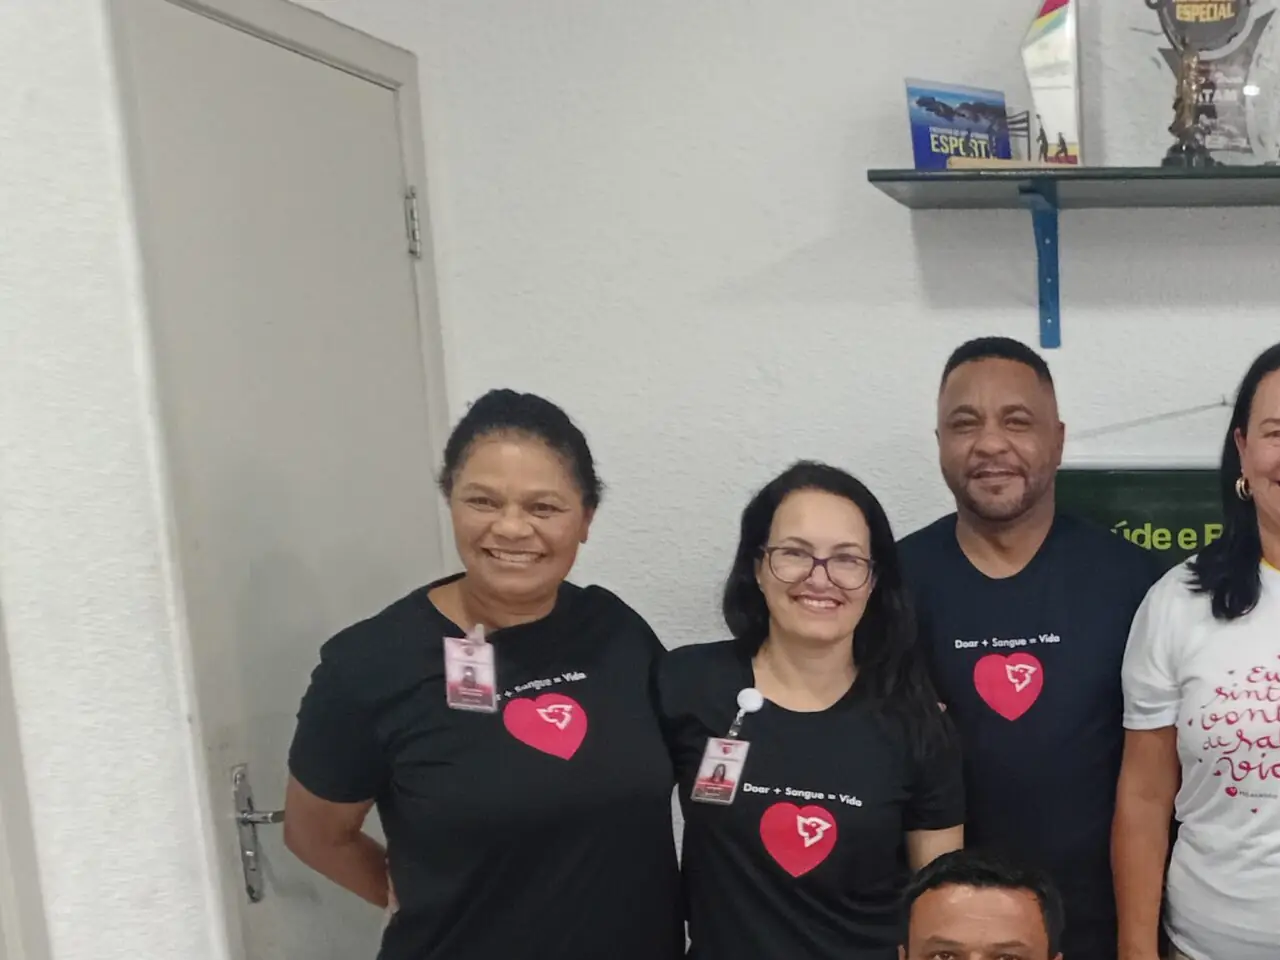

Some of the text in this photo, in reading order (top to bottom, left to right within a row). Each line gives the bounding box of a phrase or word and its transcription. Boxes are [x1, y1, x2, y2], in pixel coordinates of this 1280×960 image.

[1176, 2, 1235, 22] ESPECIAL
[931, 134, 994, 159] ESPORT
[1177, 528, 1198, 550] e
[954, 639, 979, 649] Doar
[992, 638, 1028, 648] Sangue
[1039, 633, 1061, 643] Vida
[562, 671, 587, 681] Vida
[1202, 735, 1231, 750] de
[743, 783, 770, 794] Doar
[785, 787, 824, 800] Sangue
[839, 794, 863, 807] Vida
